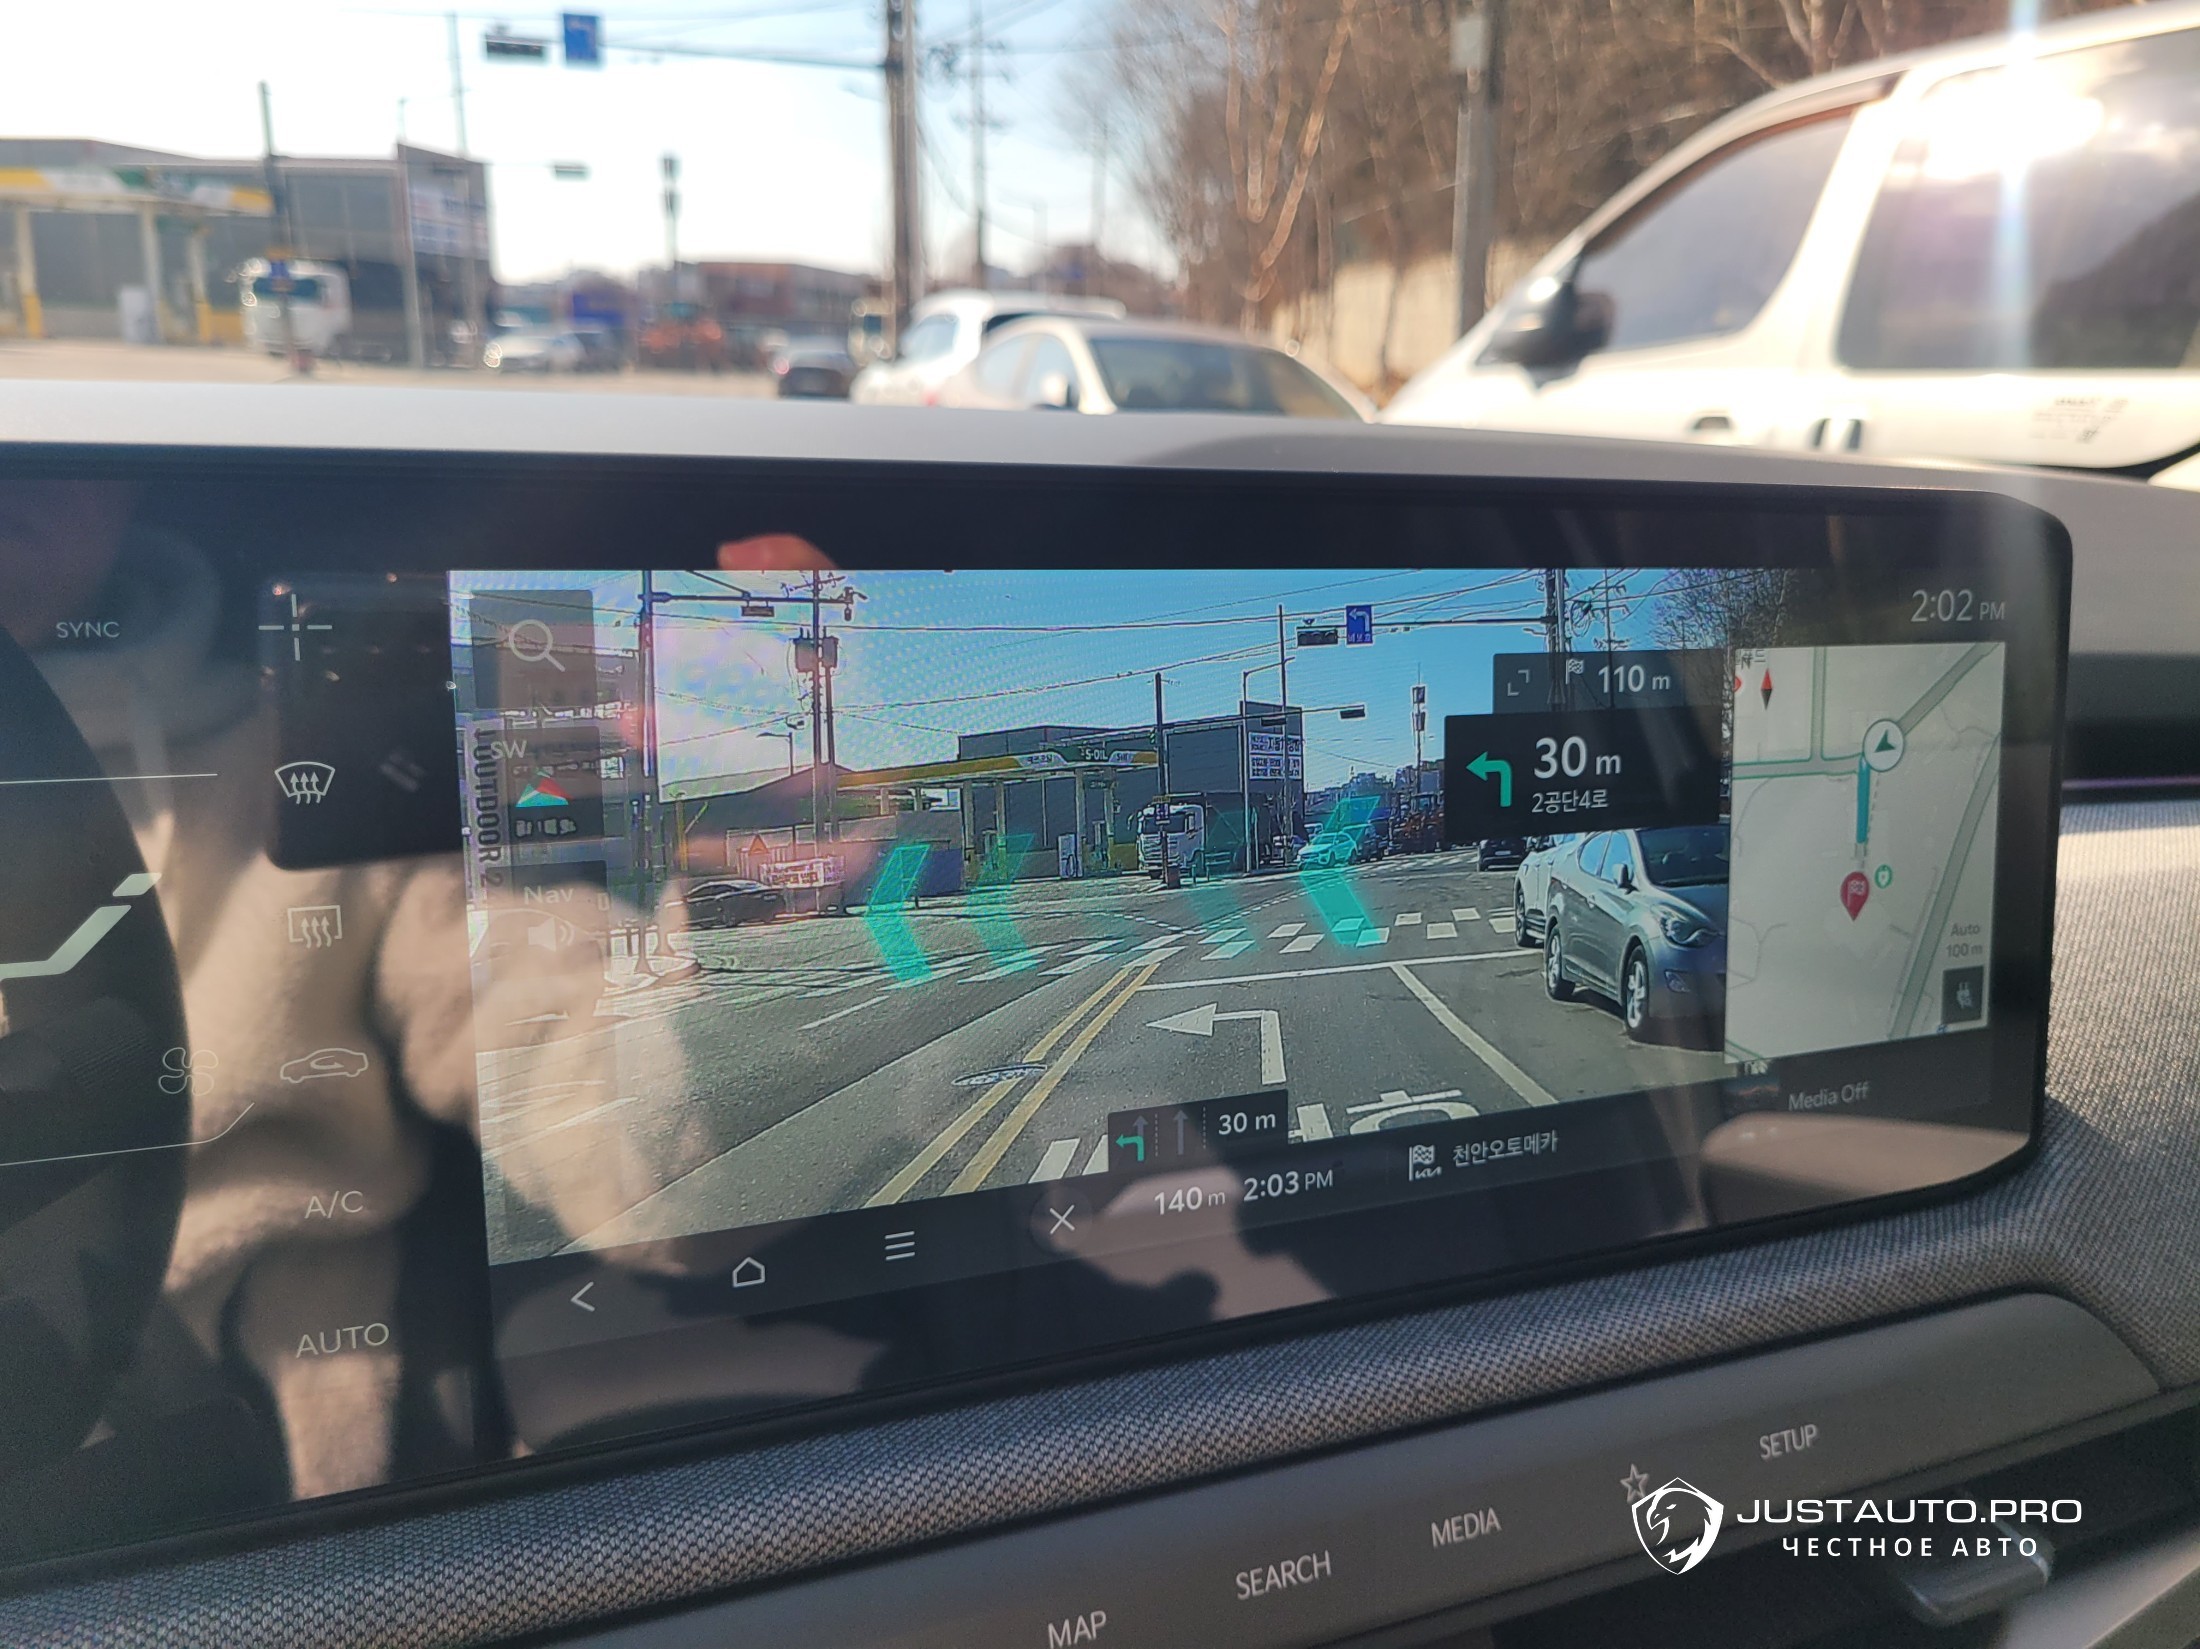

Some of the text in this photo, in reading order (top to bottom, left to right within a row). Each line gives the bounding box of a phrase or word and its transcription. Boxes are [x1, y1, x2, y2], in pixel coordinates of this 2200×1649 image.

[1910, 588, 2006, 622] 2:02 PM
[56, 621, 120, 639] SYNC
[1598, 664, 1671, 694] 110 m
[490, 739, 528, 760] SW
[1533, 735, 1622, 780] 30 m
[1531, 788, 1609, 815] 2공단4로
[523, 886, 574, 906] Nav
[1950, 922, 1981, 938] Auto
[1945, 942, 1983, 958] 100 m
[1788, 1080, 1870, 1112] Media Off
[1218, 1112, 1276, 1136] 30 m
[1452, 1129, 1560, 1168] 천안오토메카
[304, 1190, 364, 1220] A/C
[1154, 1169, 1334, 1216] 140 m 2:03 PM
[295, 1322, 390, 1359] AUTO
[1759, 1423, 1819, 1460] SETUP
[1431, 1507, 1502, 1549] MEDIA
[1235, 1550, 1332, 1600] SEARCH
[1048, 1610, 1107, 1649] MAP
